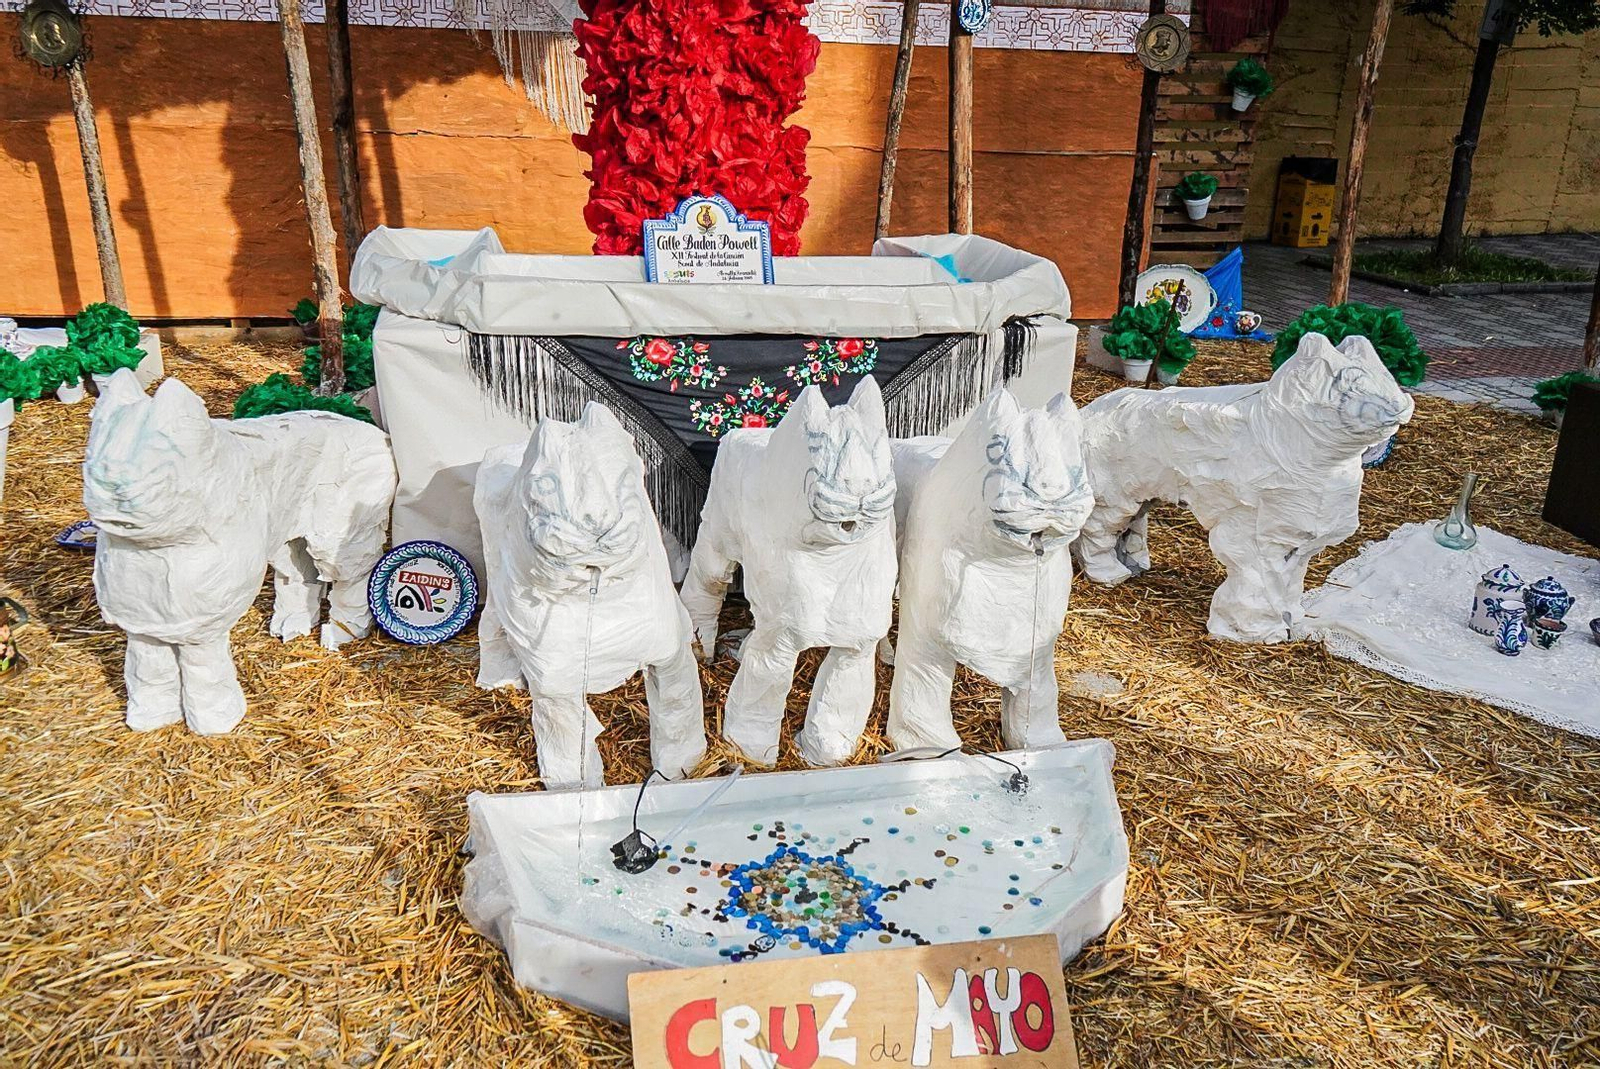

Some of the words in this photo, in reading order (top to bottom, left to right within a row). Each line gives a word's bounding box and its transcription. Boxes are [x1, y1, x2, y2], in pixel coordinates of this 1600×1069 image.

[657, 235, 680, 250] Calle
[683, 235, 716, 250] Baden
[718, 234, 758, 250] Powell
[665, 980, 857, 1069] CRUZ
[870, 1026, 908, 1063] de
[911, 965, 1055, 1067] MAYO
